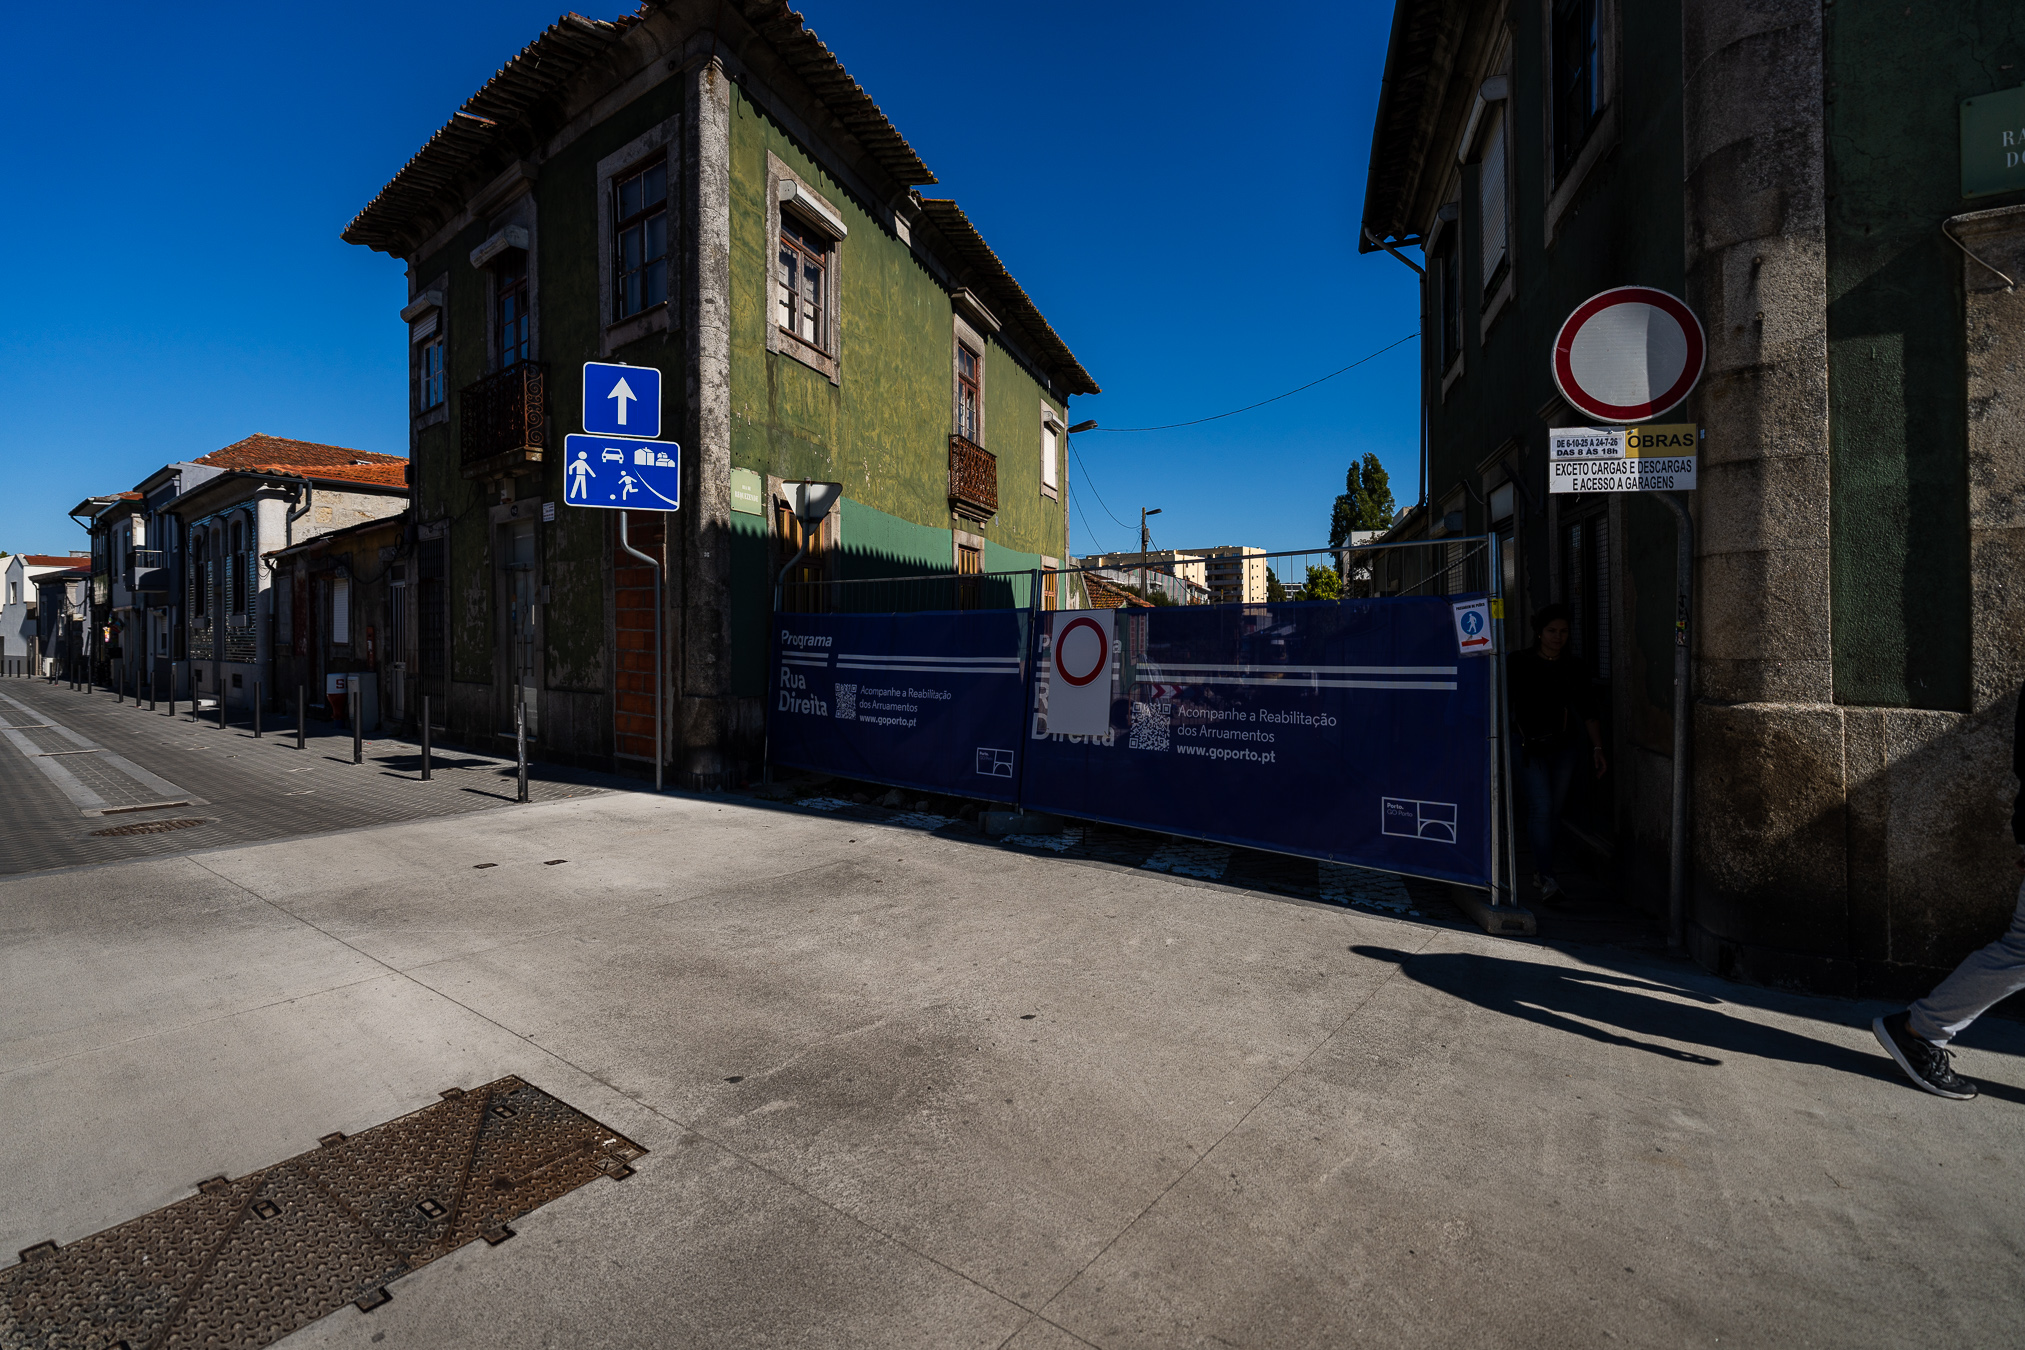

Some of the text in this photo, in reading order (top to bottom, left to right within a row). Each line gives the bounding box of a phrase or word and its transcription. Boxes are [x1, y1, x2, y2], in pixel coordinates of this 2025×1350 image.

[1557, 438, 1618, 448] DE 6-10-25 A 24-7-26
[1628, 433, 1694, 448] OBRAS
[1586, 447, 1599, 455] ÀS
[1555, 460, 1692, 476] EXCETO CARGAS E DESCARGAS
[1573, 476, 1674, 491] E ACESSO A GARAGENS
[781, 629, 833, 649] Programa
[780, 666, 806, 689] Rua
[860, 685, 901, 698] Acompanhe
[908, 687, 952, 701] Reabilitação
[778, 689, 828, 716] Direita
[859, 699, 918, 713] dos Arruamentos
[859, 714, 917, 728] www.goporto.pt
[1178, 705, 1337, 728] Acompanhe a Reabilitação
[1177, 723, 1275, 743] dos Arruamentos
[1176, 744, 1276, 764] www.goporto.pt
